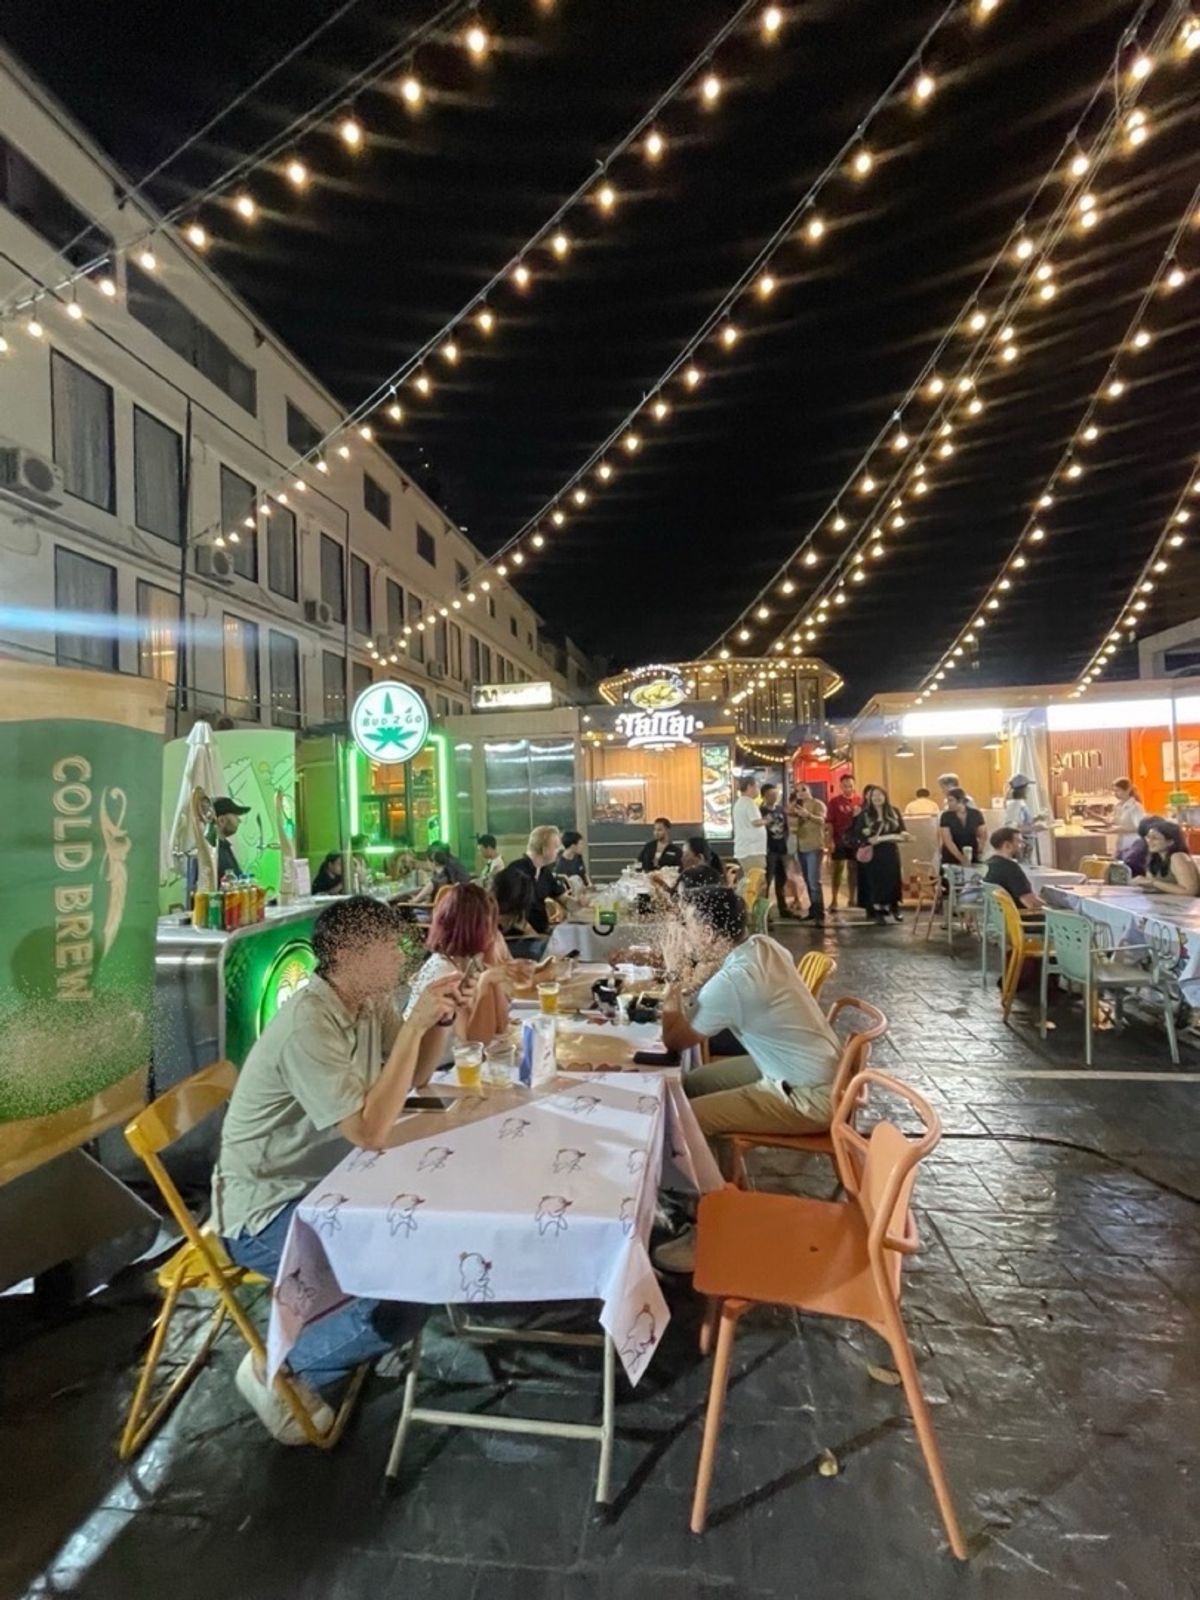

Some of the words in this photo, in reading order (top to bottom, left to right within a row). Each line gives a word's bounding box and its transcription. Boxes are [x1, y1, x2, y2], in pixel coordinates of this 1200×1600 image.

[393, 715, 400, 725] 2
[53, 755, 93, 872] COLD
[54, 883, 94, 1002] BREW
